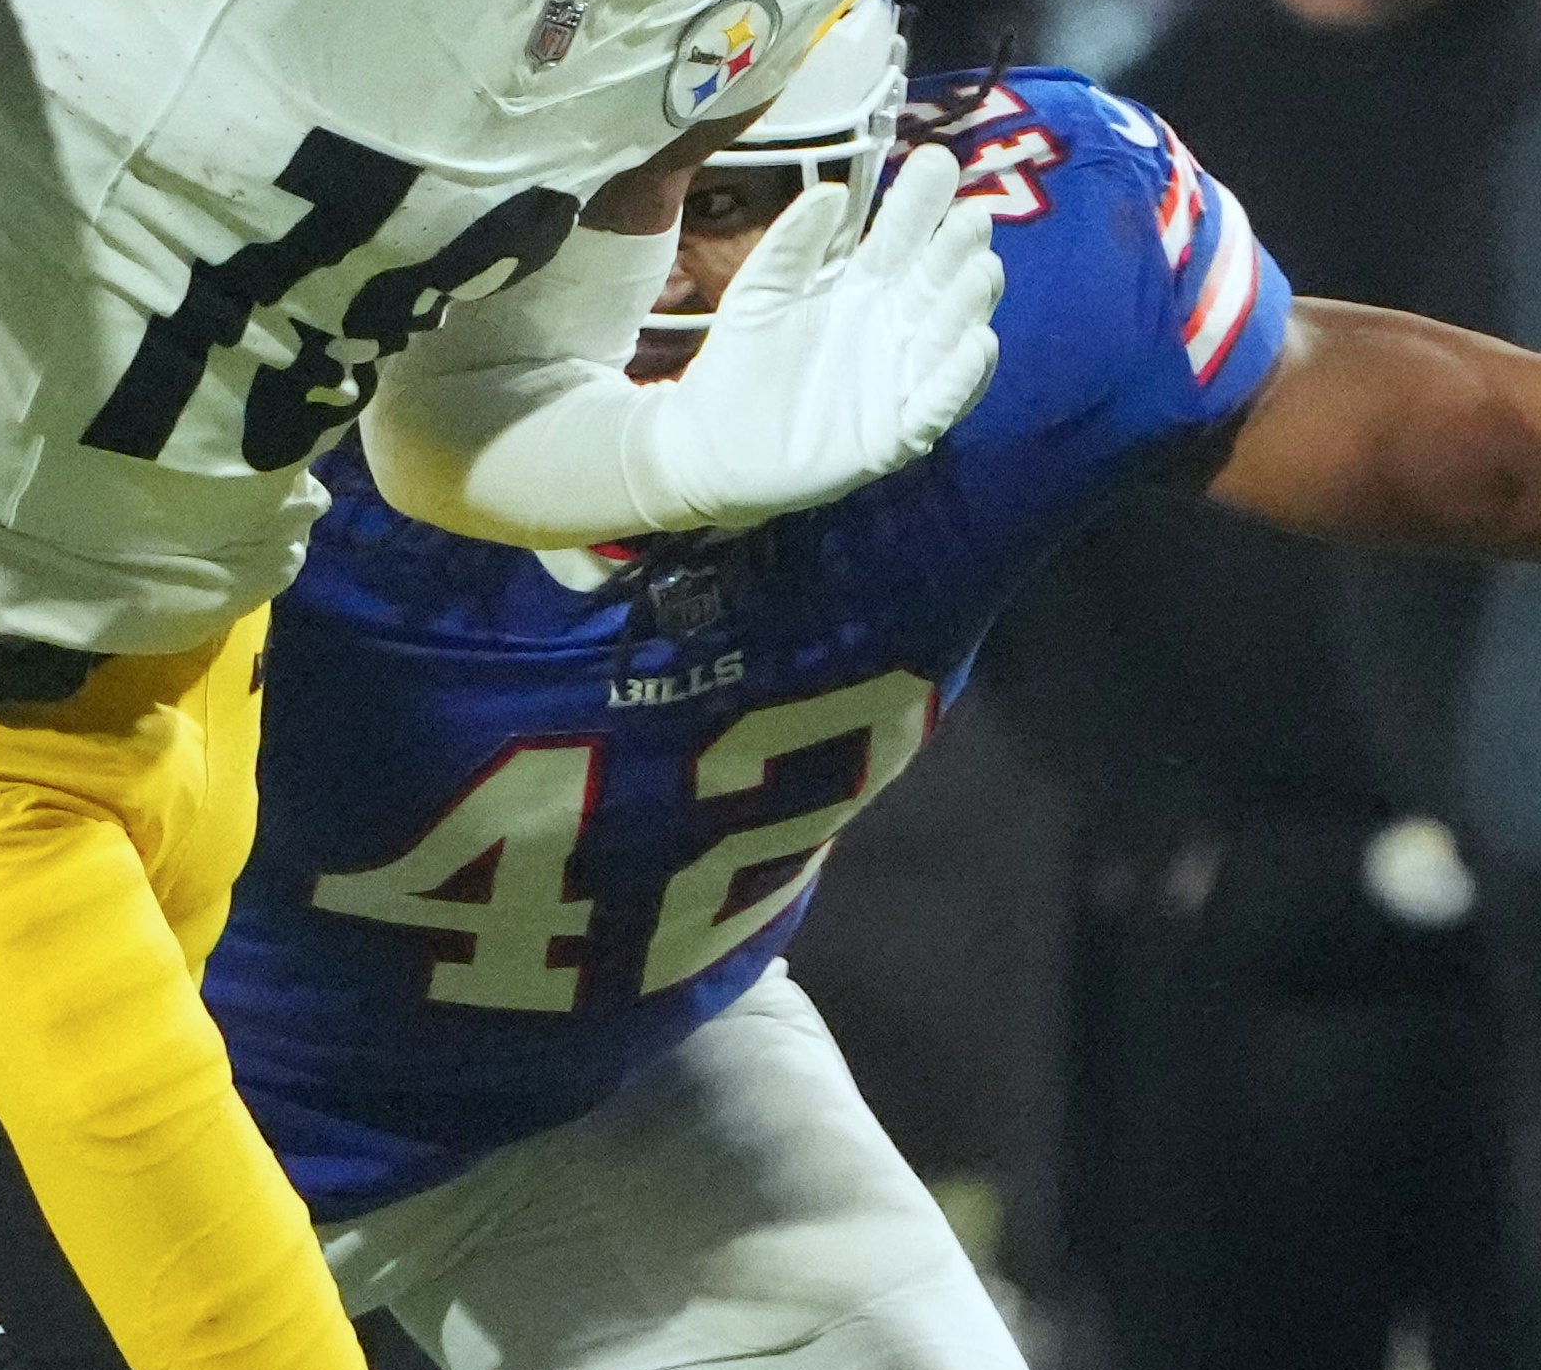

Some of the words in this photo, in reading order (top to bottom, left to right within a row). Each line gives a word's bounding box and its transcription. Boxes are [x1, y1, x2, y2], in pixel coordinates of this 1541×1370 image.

[79, 125, 582, 474] 18
[311, 669, 940, 1014] 42
[607, 649, 746, 709] BILLS
